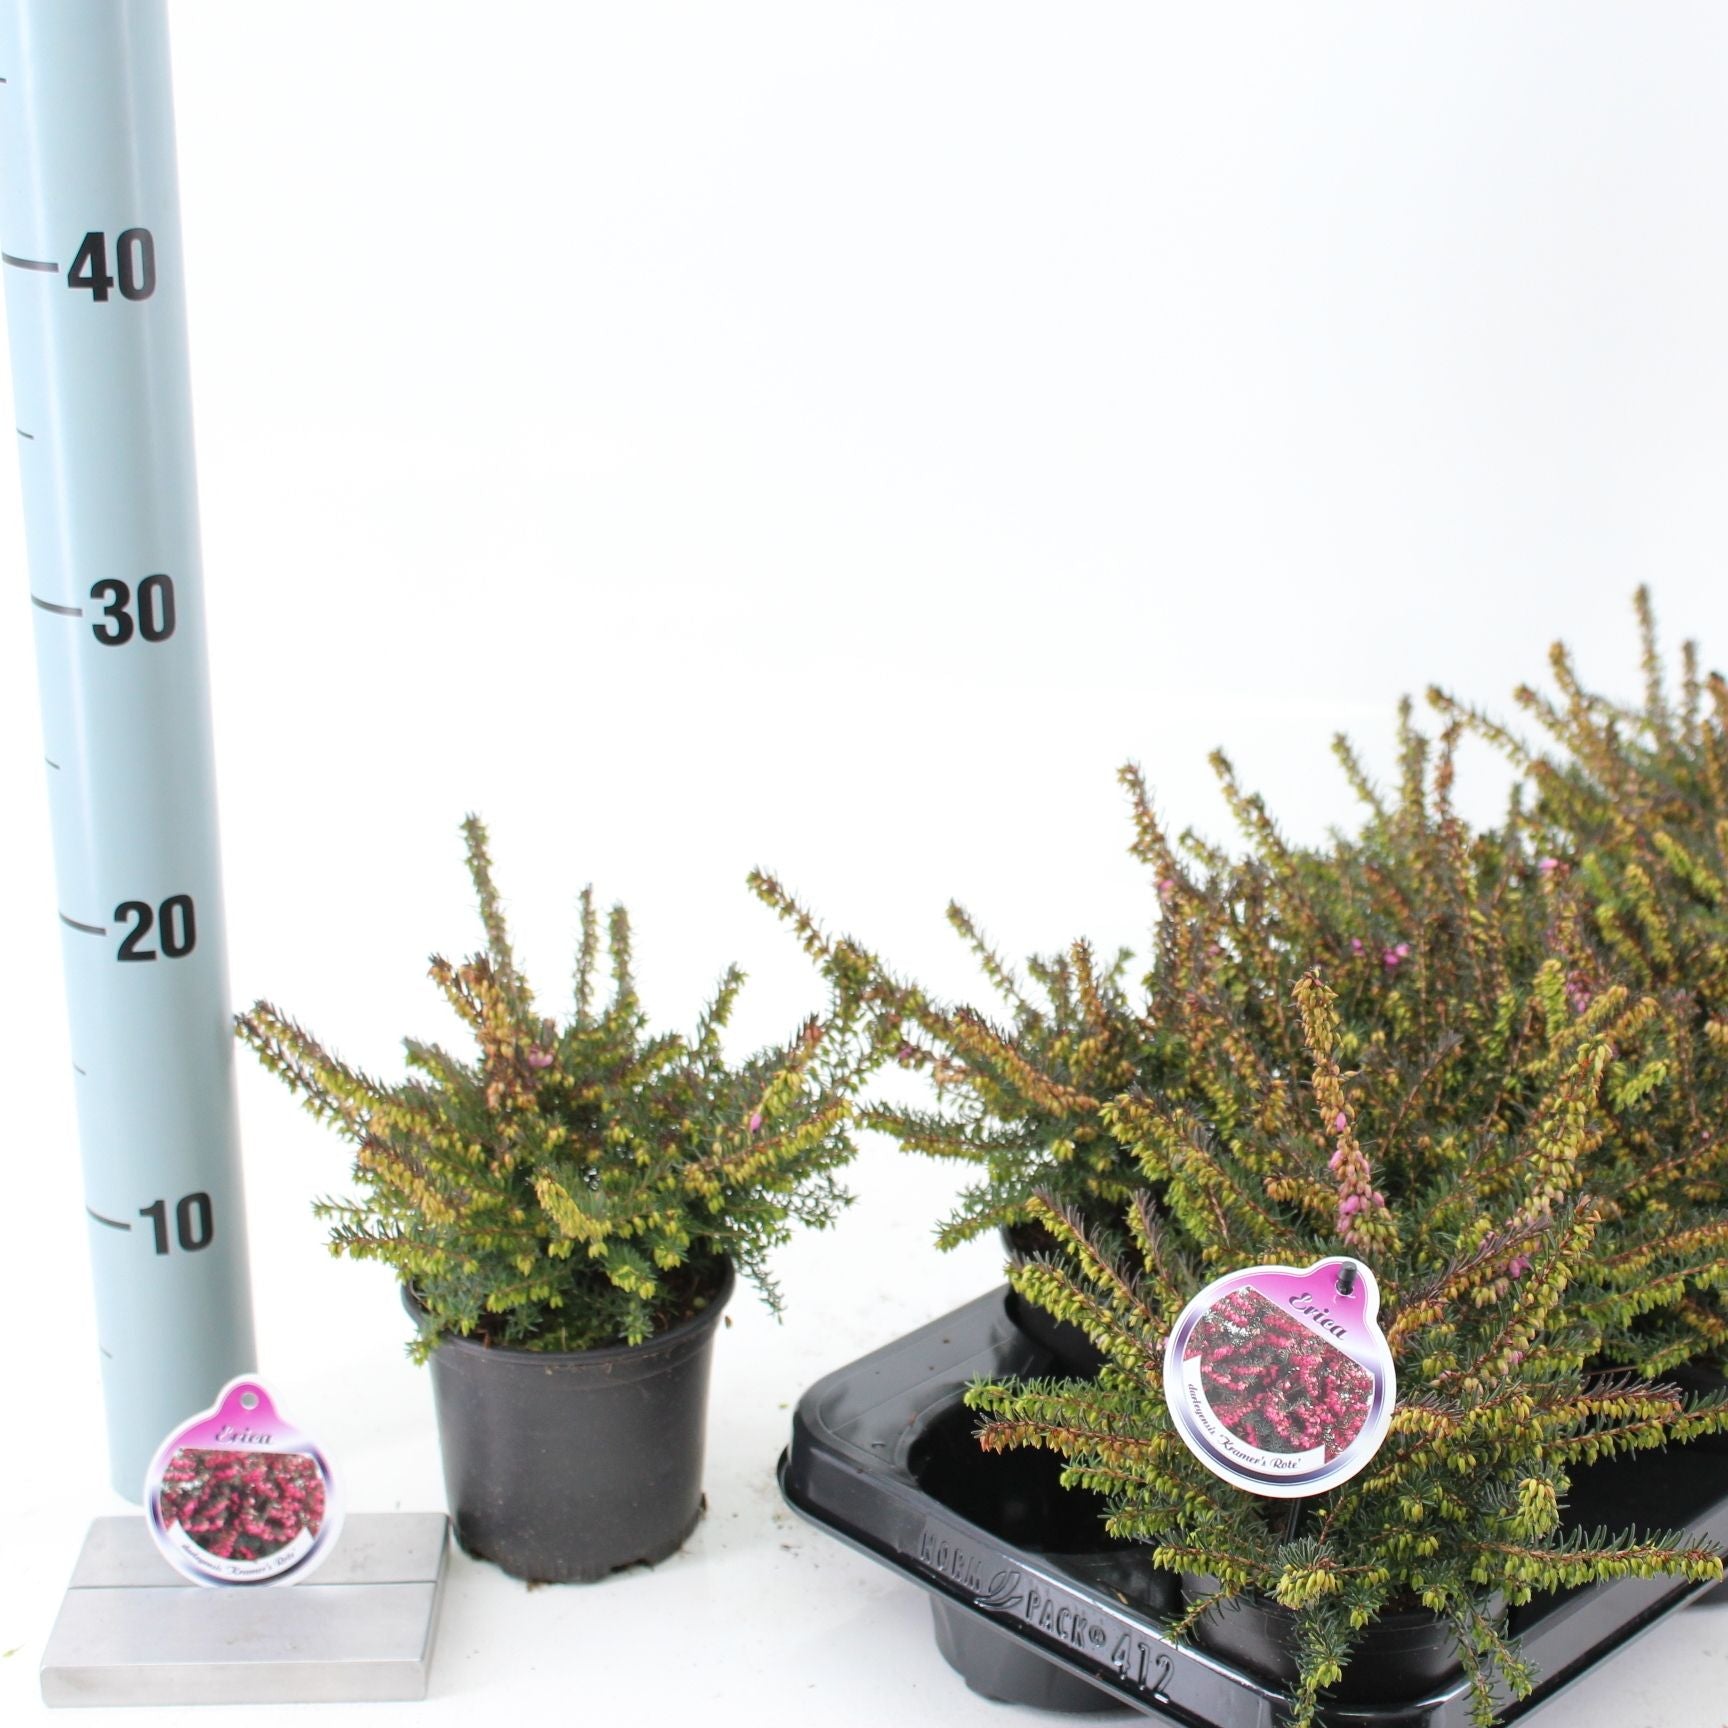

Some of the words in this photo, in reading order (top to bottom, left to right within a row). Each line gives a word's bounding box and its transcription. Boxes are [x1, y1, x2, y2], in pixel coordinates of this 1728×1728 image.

[66, 227, 157, 303] 40
[89, 573, 177, 647] 30
[113, 894, 197, 962] 20
[138, 1192, 215, 1256] 10
[1288, 1292, 1348, 1341] Erica
[215, 1424, 273, 1445] Erica
[920, 1531, 984, 1593] NORM
[1110, 1633, 1176, 1705] 412
